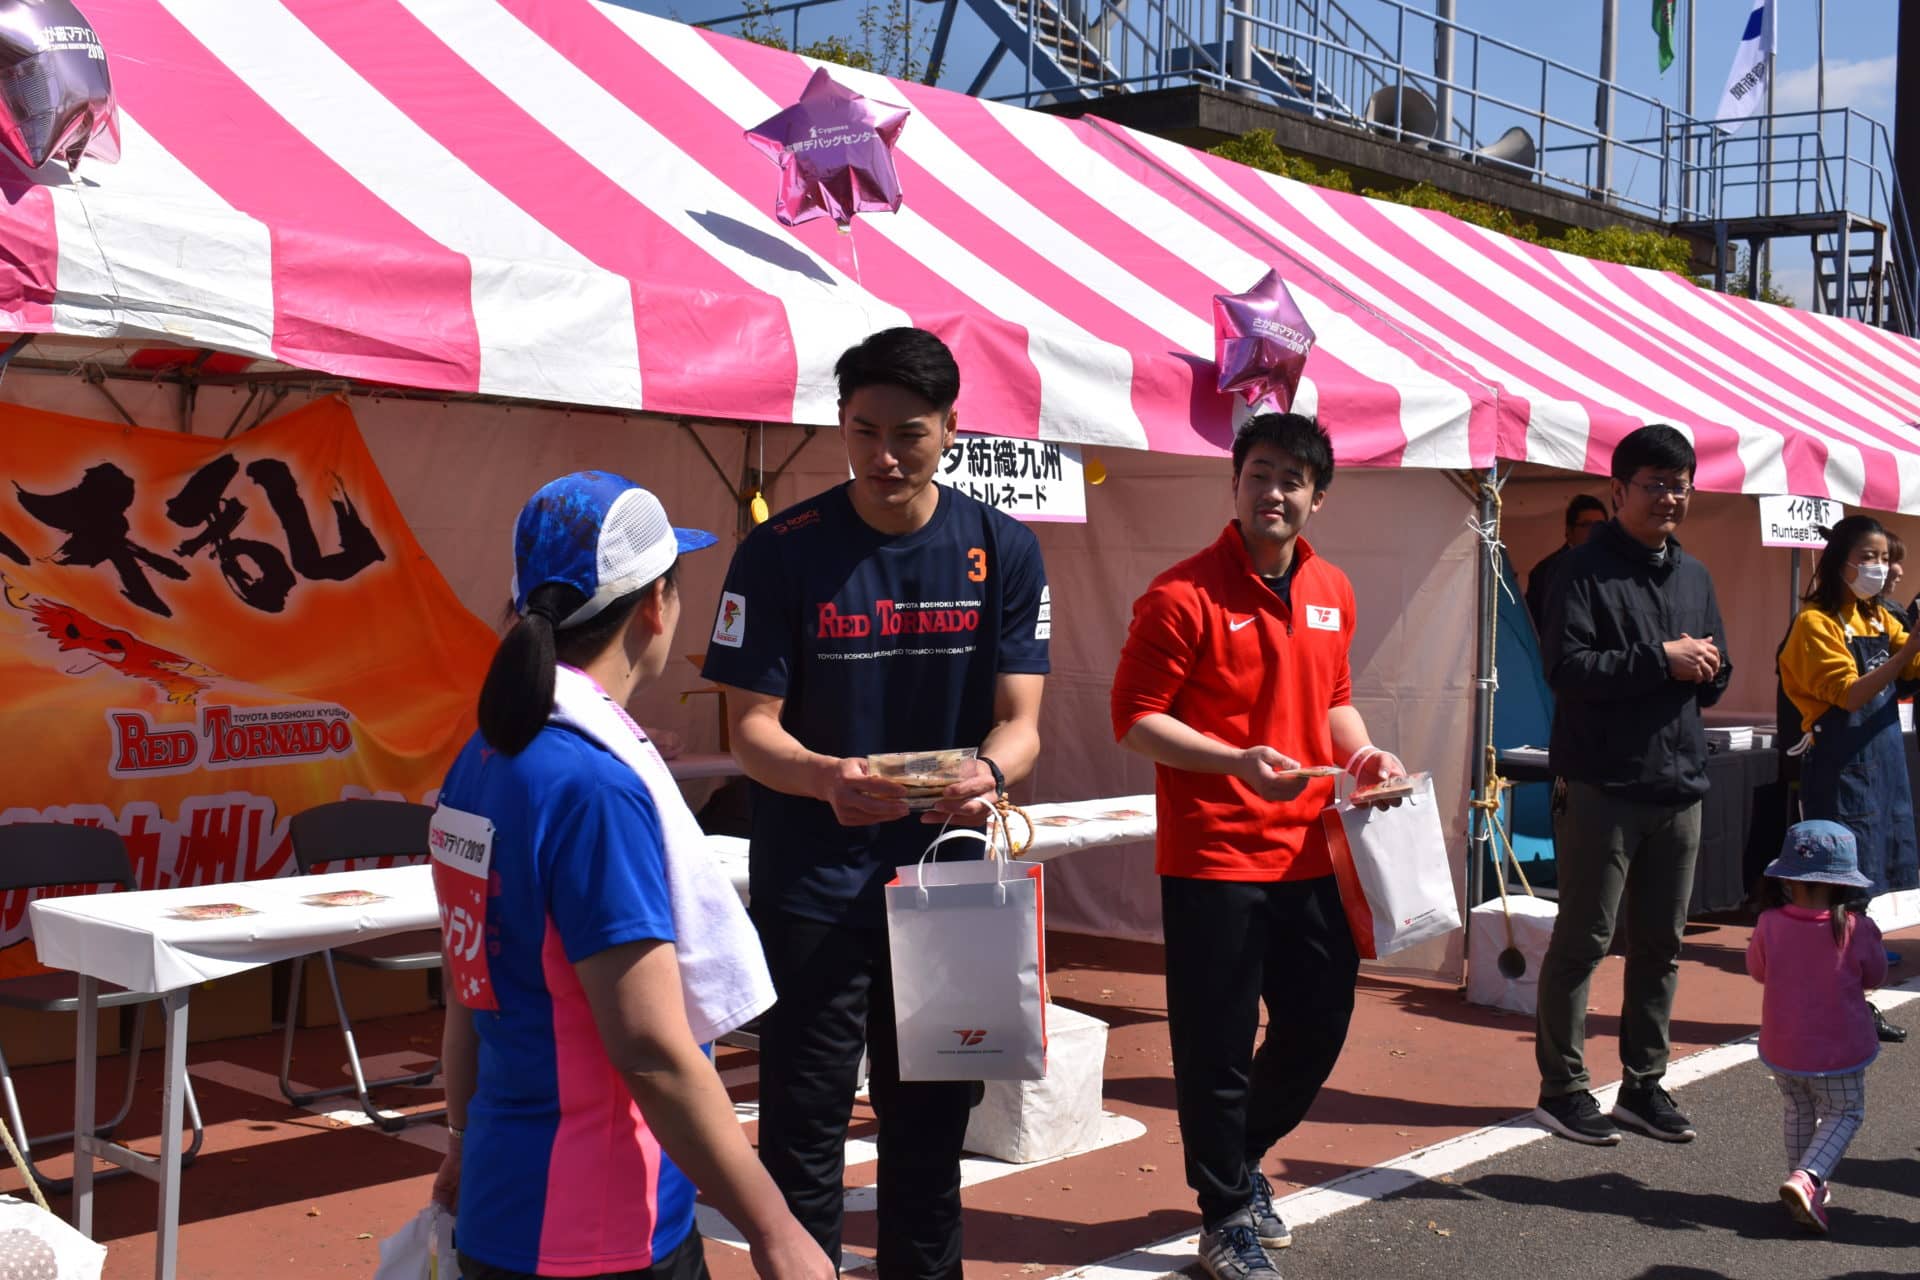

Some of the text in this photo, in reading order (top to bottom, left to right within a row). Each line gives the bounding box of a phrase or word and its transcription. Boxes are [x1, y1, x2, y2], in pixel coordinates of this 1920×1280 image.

[935, 437, 1063, 482] タ紡織九州
[967, 546, 988, 583] 3
[815, 599, 980, 639] RED TORNADO
[233, 712, 268, 723] TOYOTA
[270, 709, 316, 721] BOSHOKU
[112, 704, 353, 772] RED TORNADO
